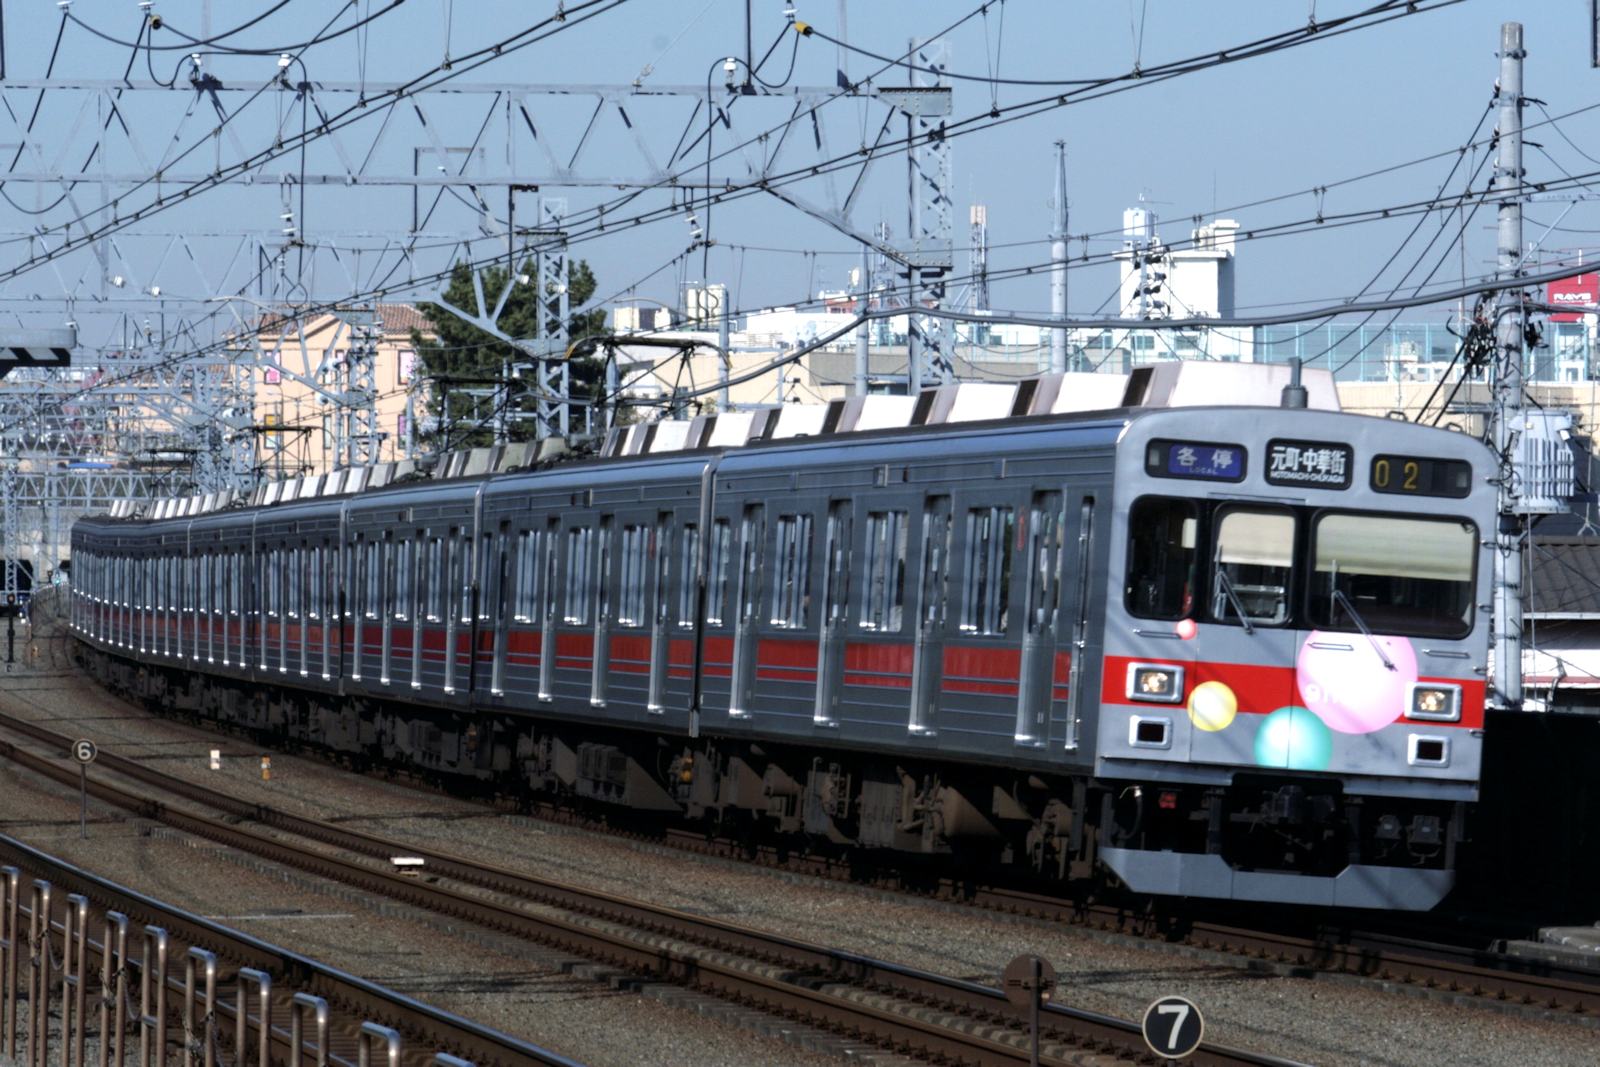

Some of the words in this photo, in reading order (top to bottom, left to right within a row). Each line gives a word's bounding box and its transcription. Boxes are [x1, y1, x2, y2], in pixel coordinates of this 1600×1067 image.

[1553, 293, 1592, 301] RAYS
[1176, 446, 1233, 469] 各停
[78, 741, 91, 760] 6
[1158, 1004, 1189, 1049] 7
